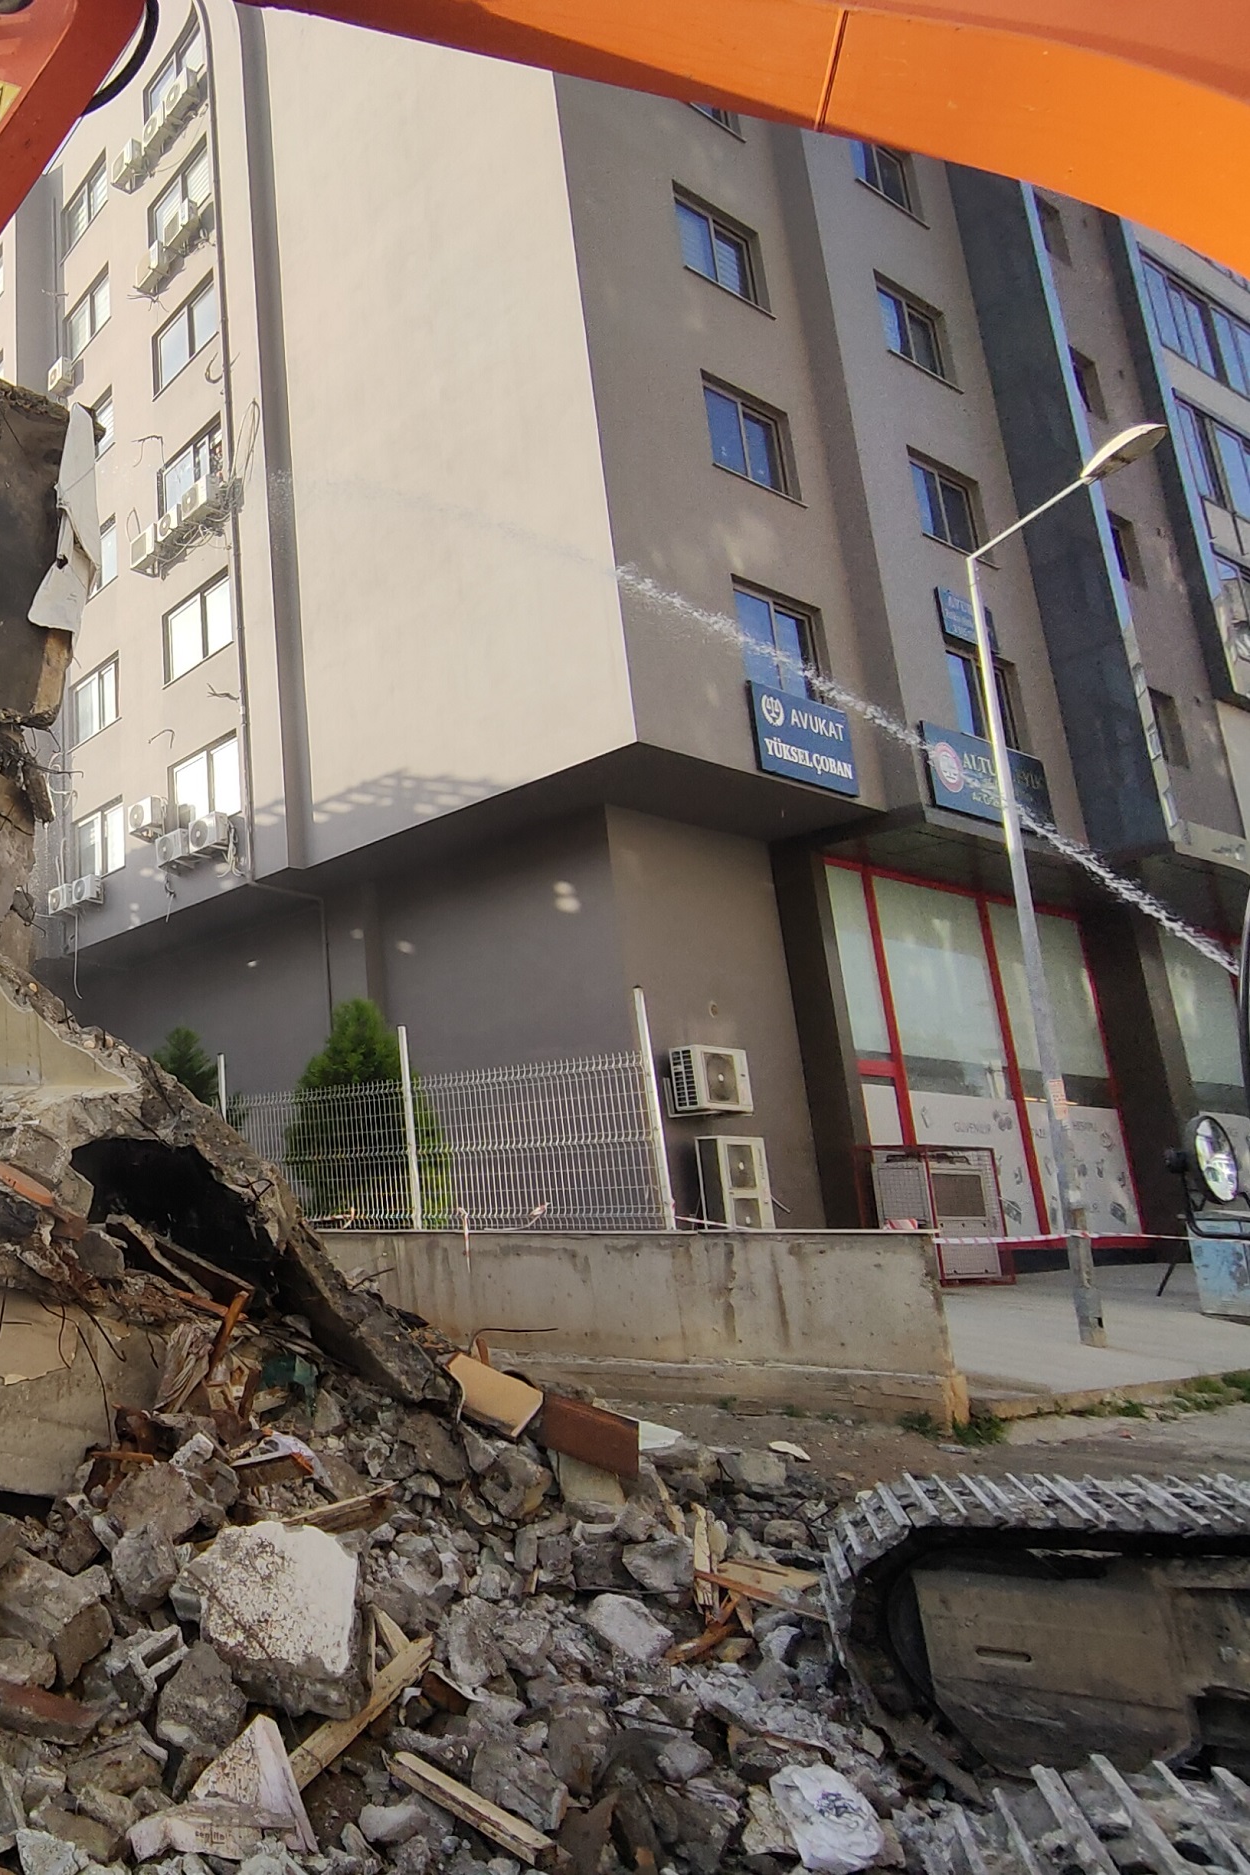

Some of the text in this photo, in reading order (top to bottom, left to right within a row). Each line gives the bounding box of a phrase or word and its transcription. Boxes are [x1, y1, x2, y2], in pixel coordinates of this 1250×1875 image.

[791, 709, 844, 741] AVUKAT
[764, 737, 853, 779] YÜKSEL ÇOBAN
